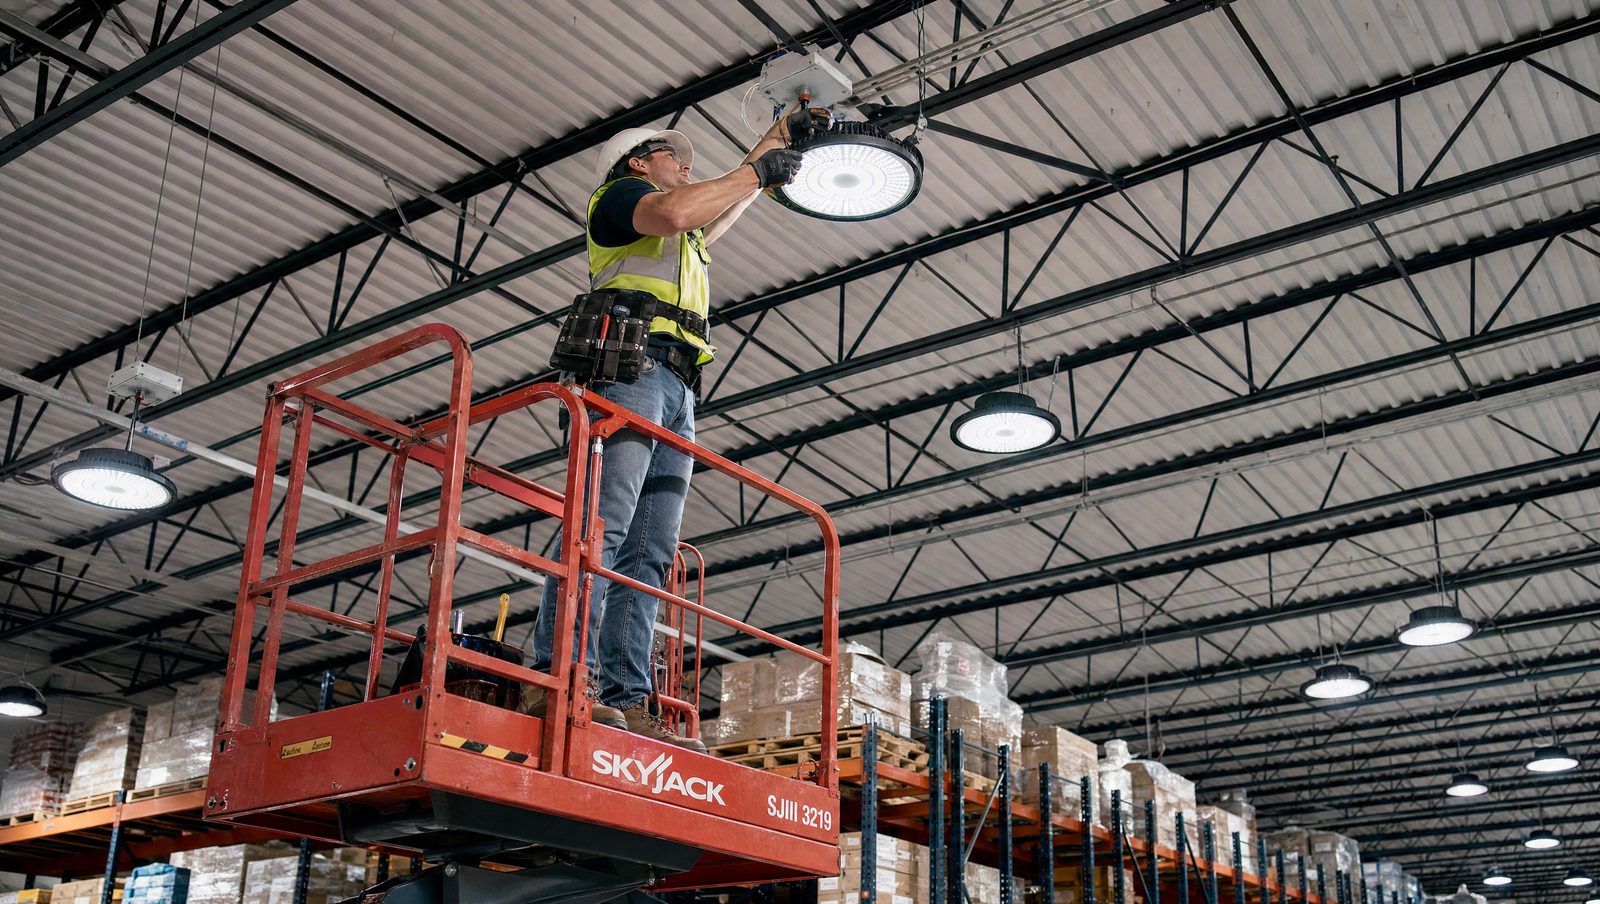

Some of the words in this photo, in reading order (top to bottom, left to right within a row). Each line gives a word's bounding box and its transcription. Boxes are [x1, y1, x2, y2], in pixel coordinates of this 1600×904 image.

[592, 750, 726, 806] SKYJACK
[767, 795, 798, 822] SJIII
[802, 805, 832, 831] 3219
